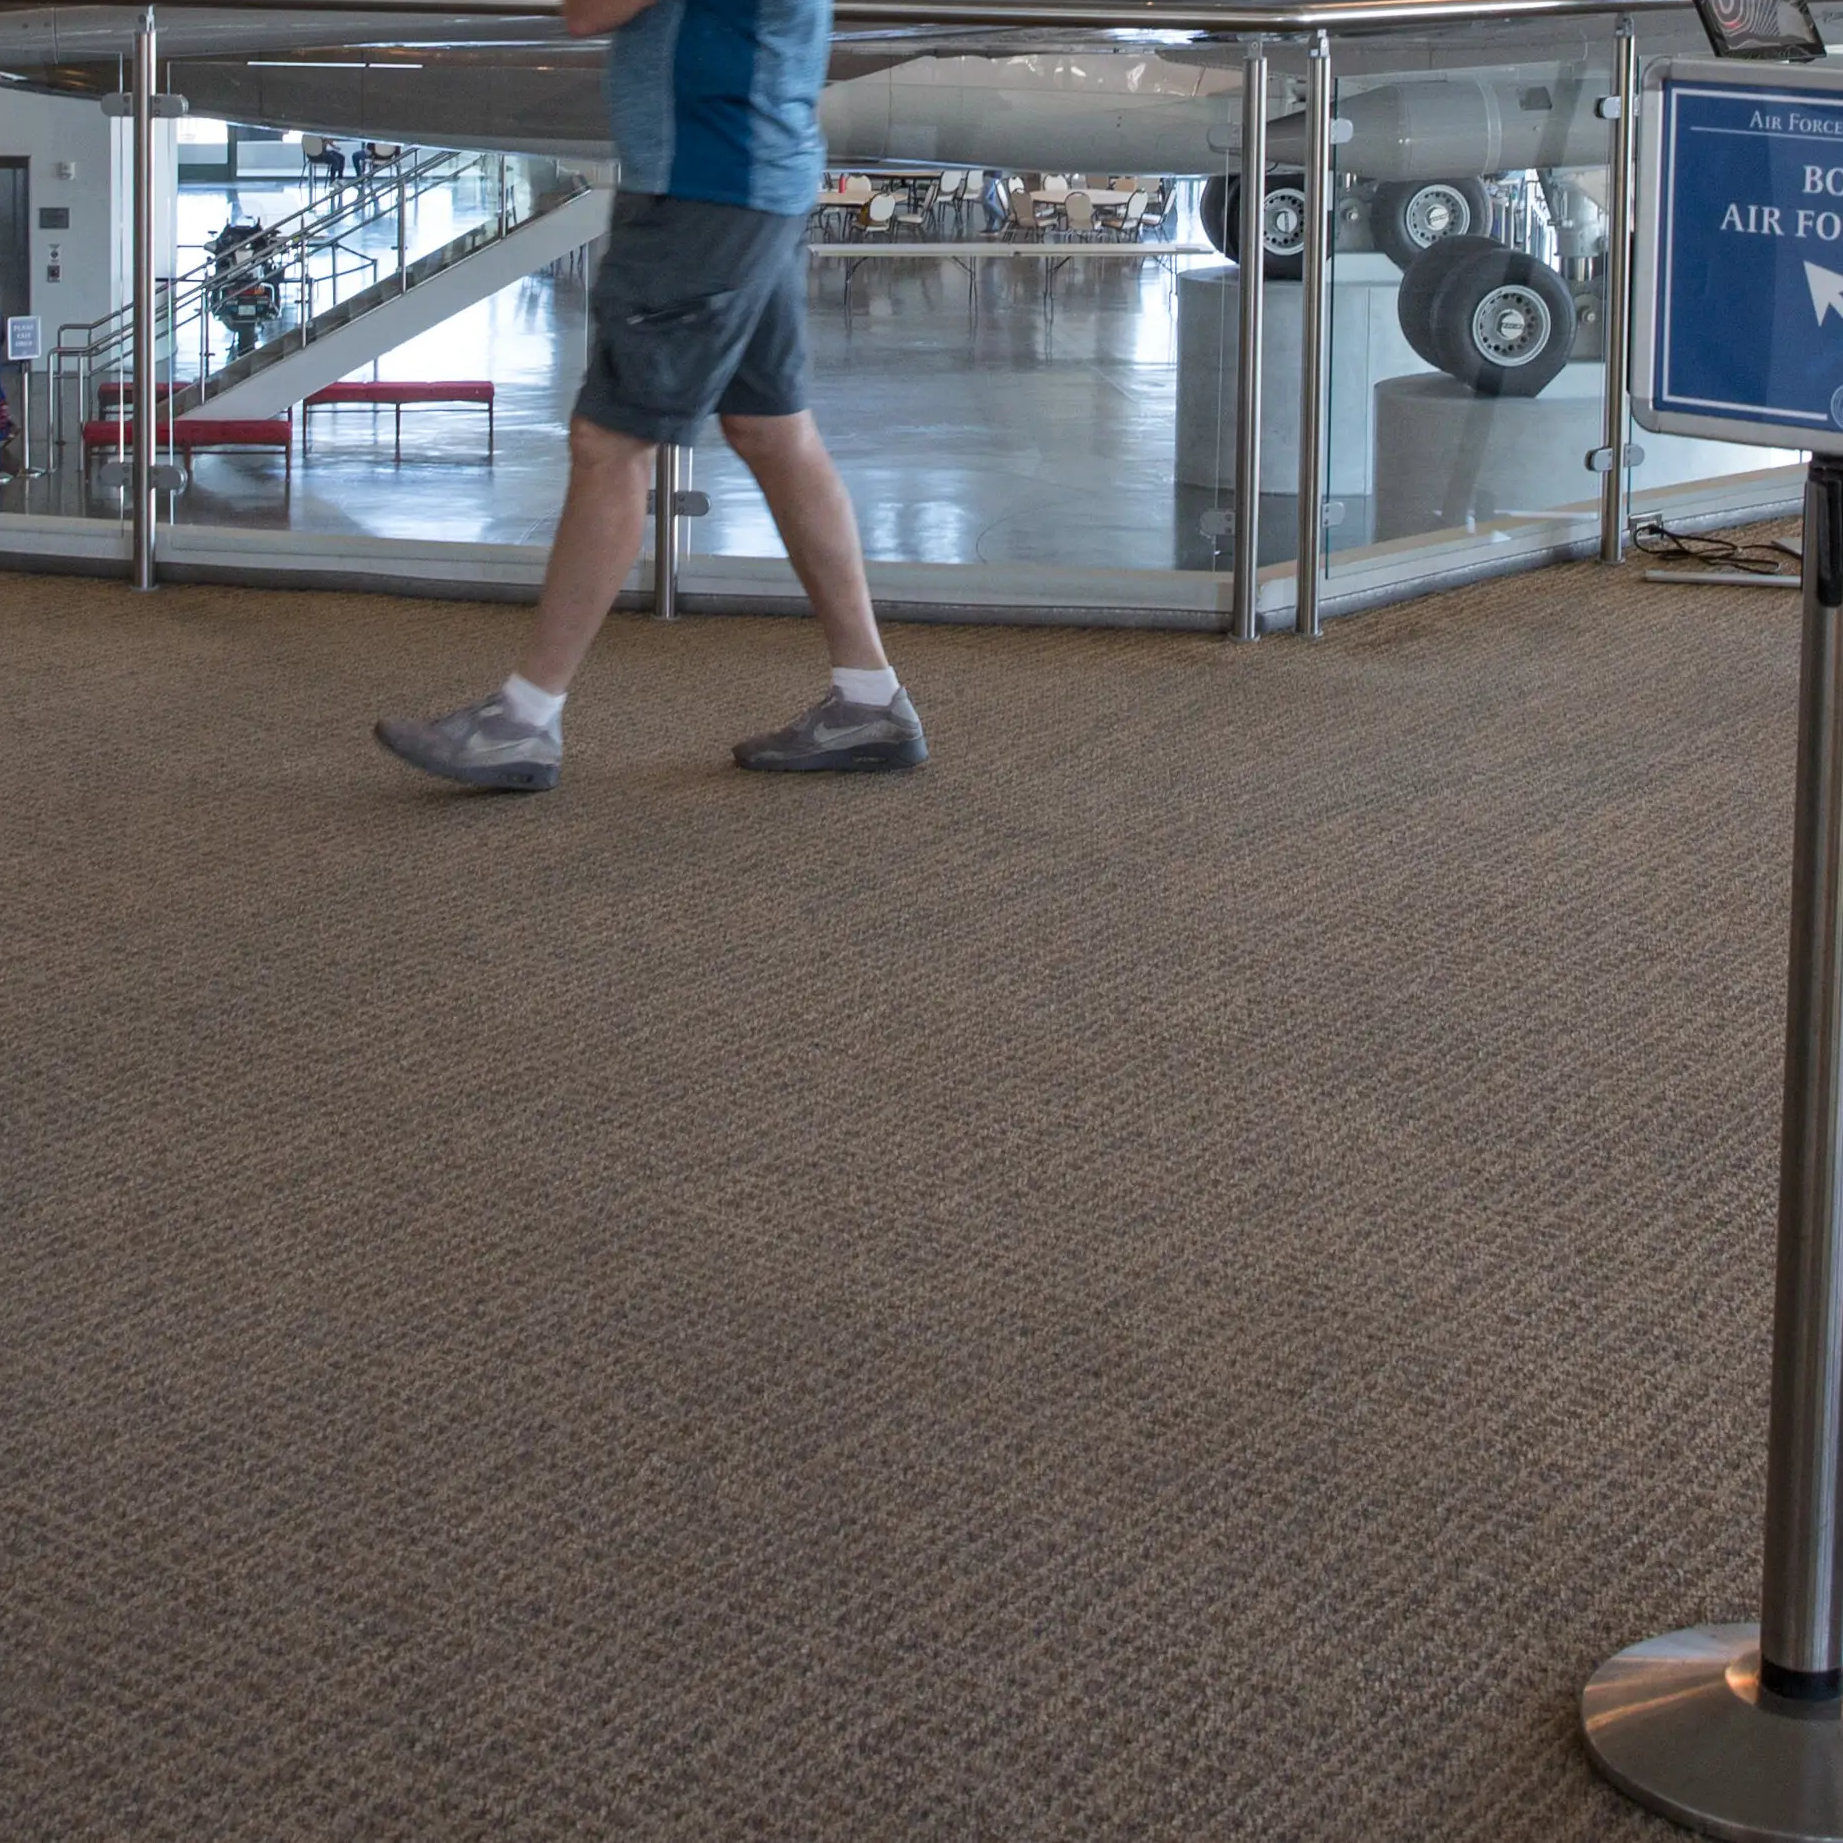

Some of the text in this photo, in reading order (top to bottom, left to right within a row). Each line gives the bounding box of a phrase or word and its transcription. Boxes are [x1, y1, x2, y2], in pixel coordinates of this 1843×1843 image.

[1749, 110, 1782, 130] AIR
[1788, 112, 1843, 135] FORCE
[1720, 203, 1784, 236] AIR
